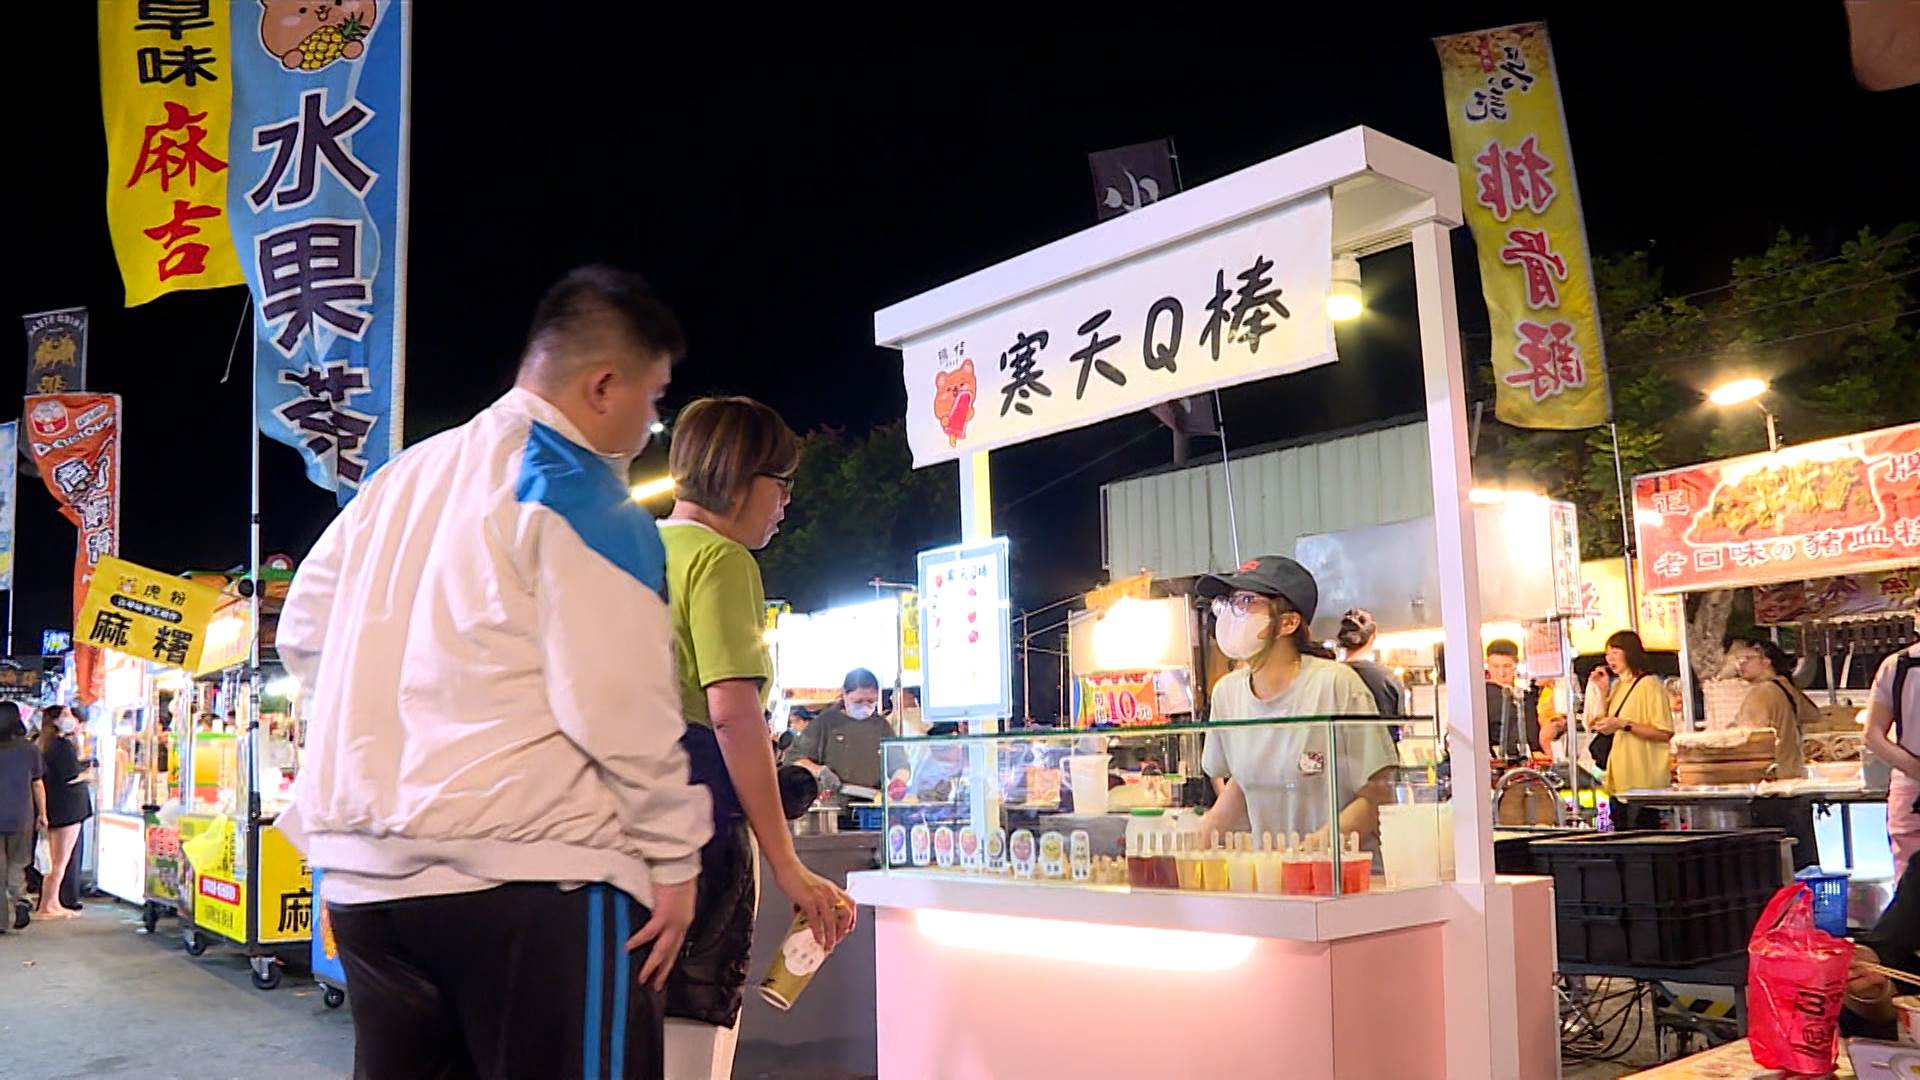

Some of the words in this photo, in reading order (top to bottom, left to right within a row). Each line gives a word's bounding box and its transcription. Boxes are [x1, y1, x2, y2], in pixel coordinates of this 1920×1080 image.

[247, 89, 378, 488] 水果茶
[1000, 256, 1289, 417] 寒天Q棒
[89, 610, 193, 665] 麻糬
